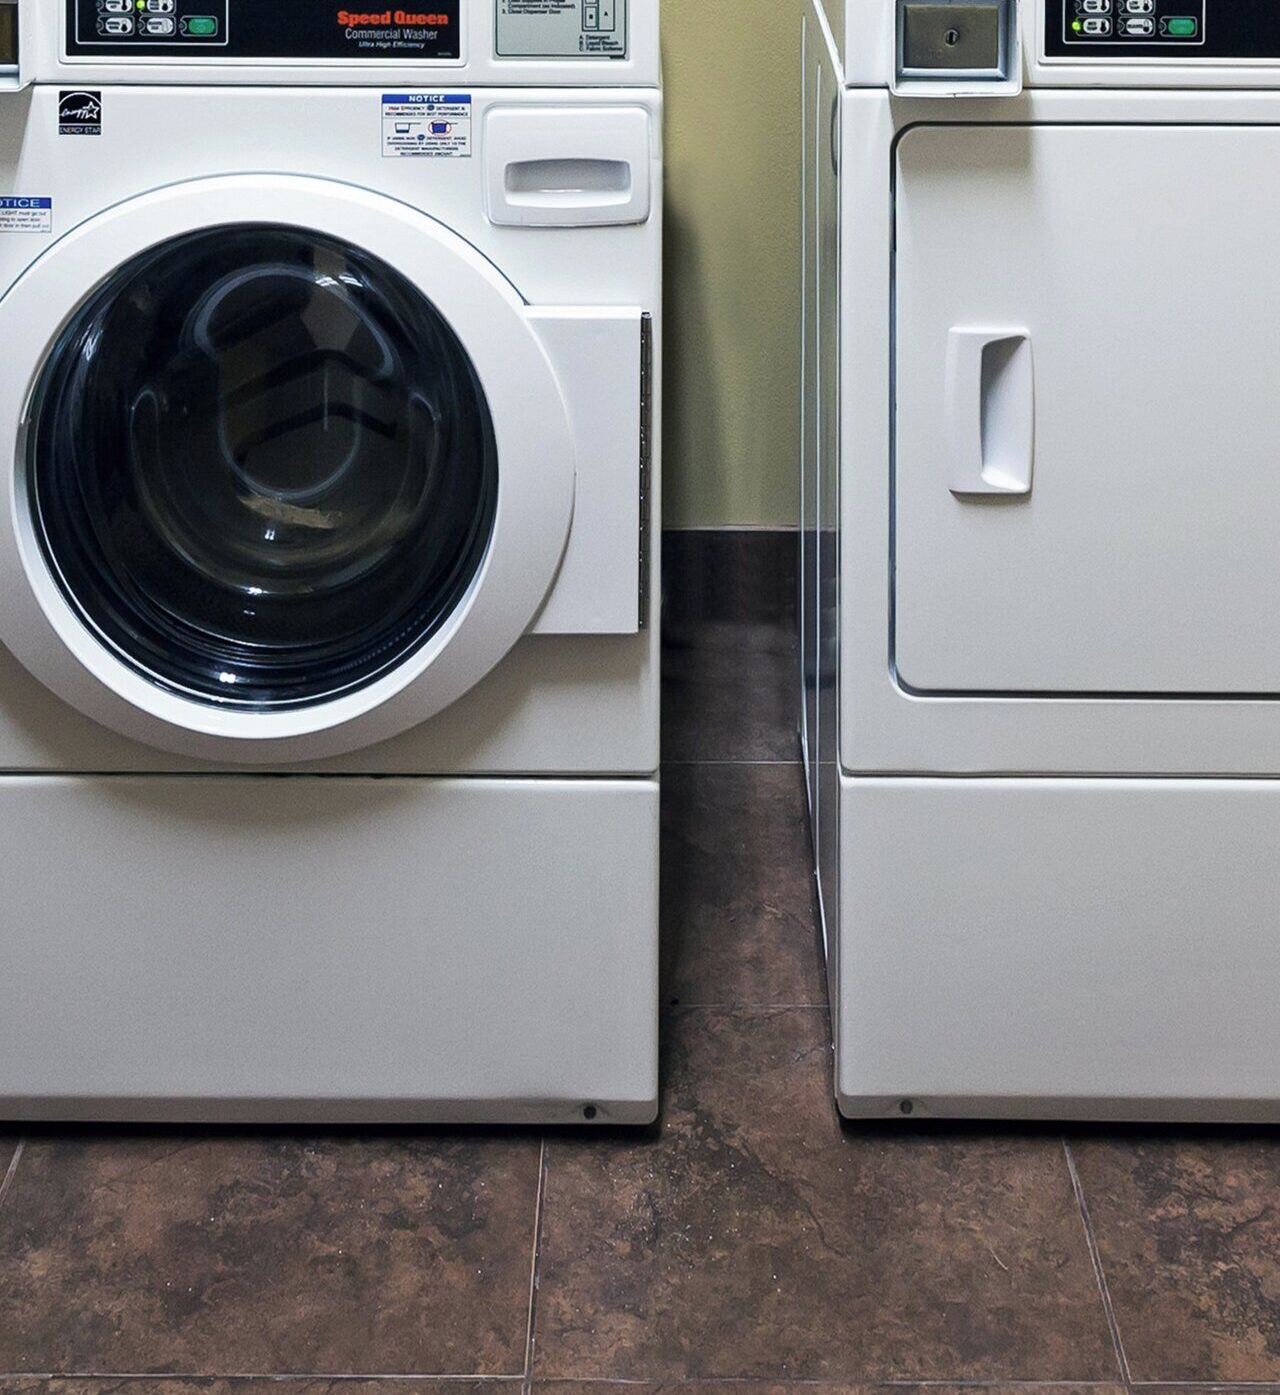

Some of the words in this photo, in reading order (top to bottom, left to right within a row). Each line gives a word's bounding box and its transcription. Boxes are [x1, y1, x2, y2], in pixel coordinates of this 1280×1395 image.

[337, 10, 391, 27] Speed
[394, 10, 449, 25] Queen
[345, 28, 401, 40] Commercial
[403, 28, 438, 40] Washer
[392, 41, 425, 49] Efficiency
